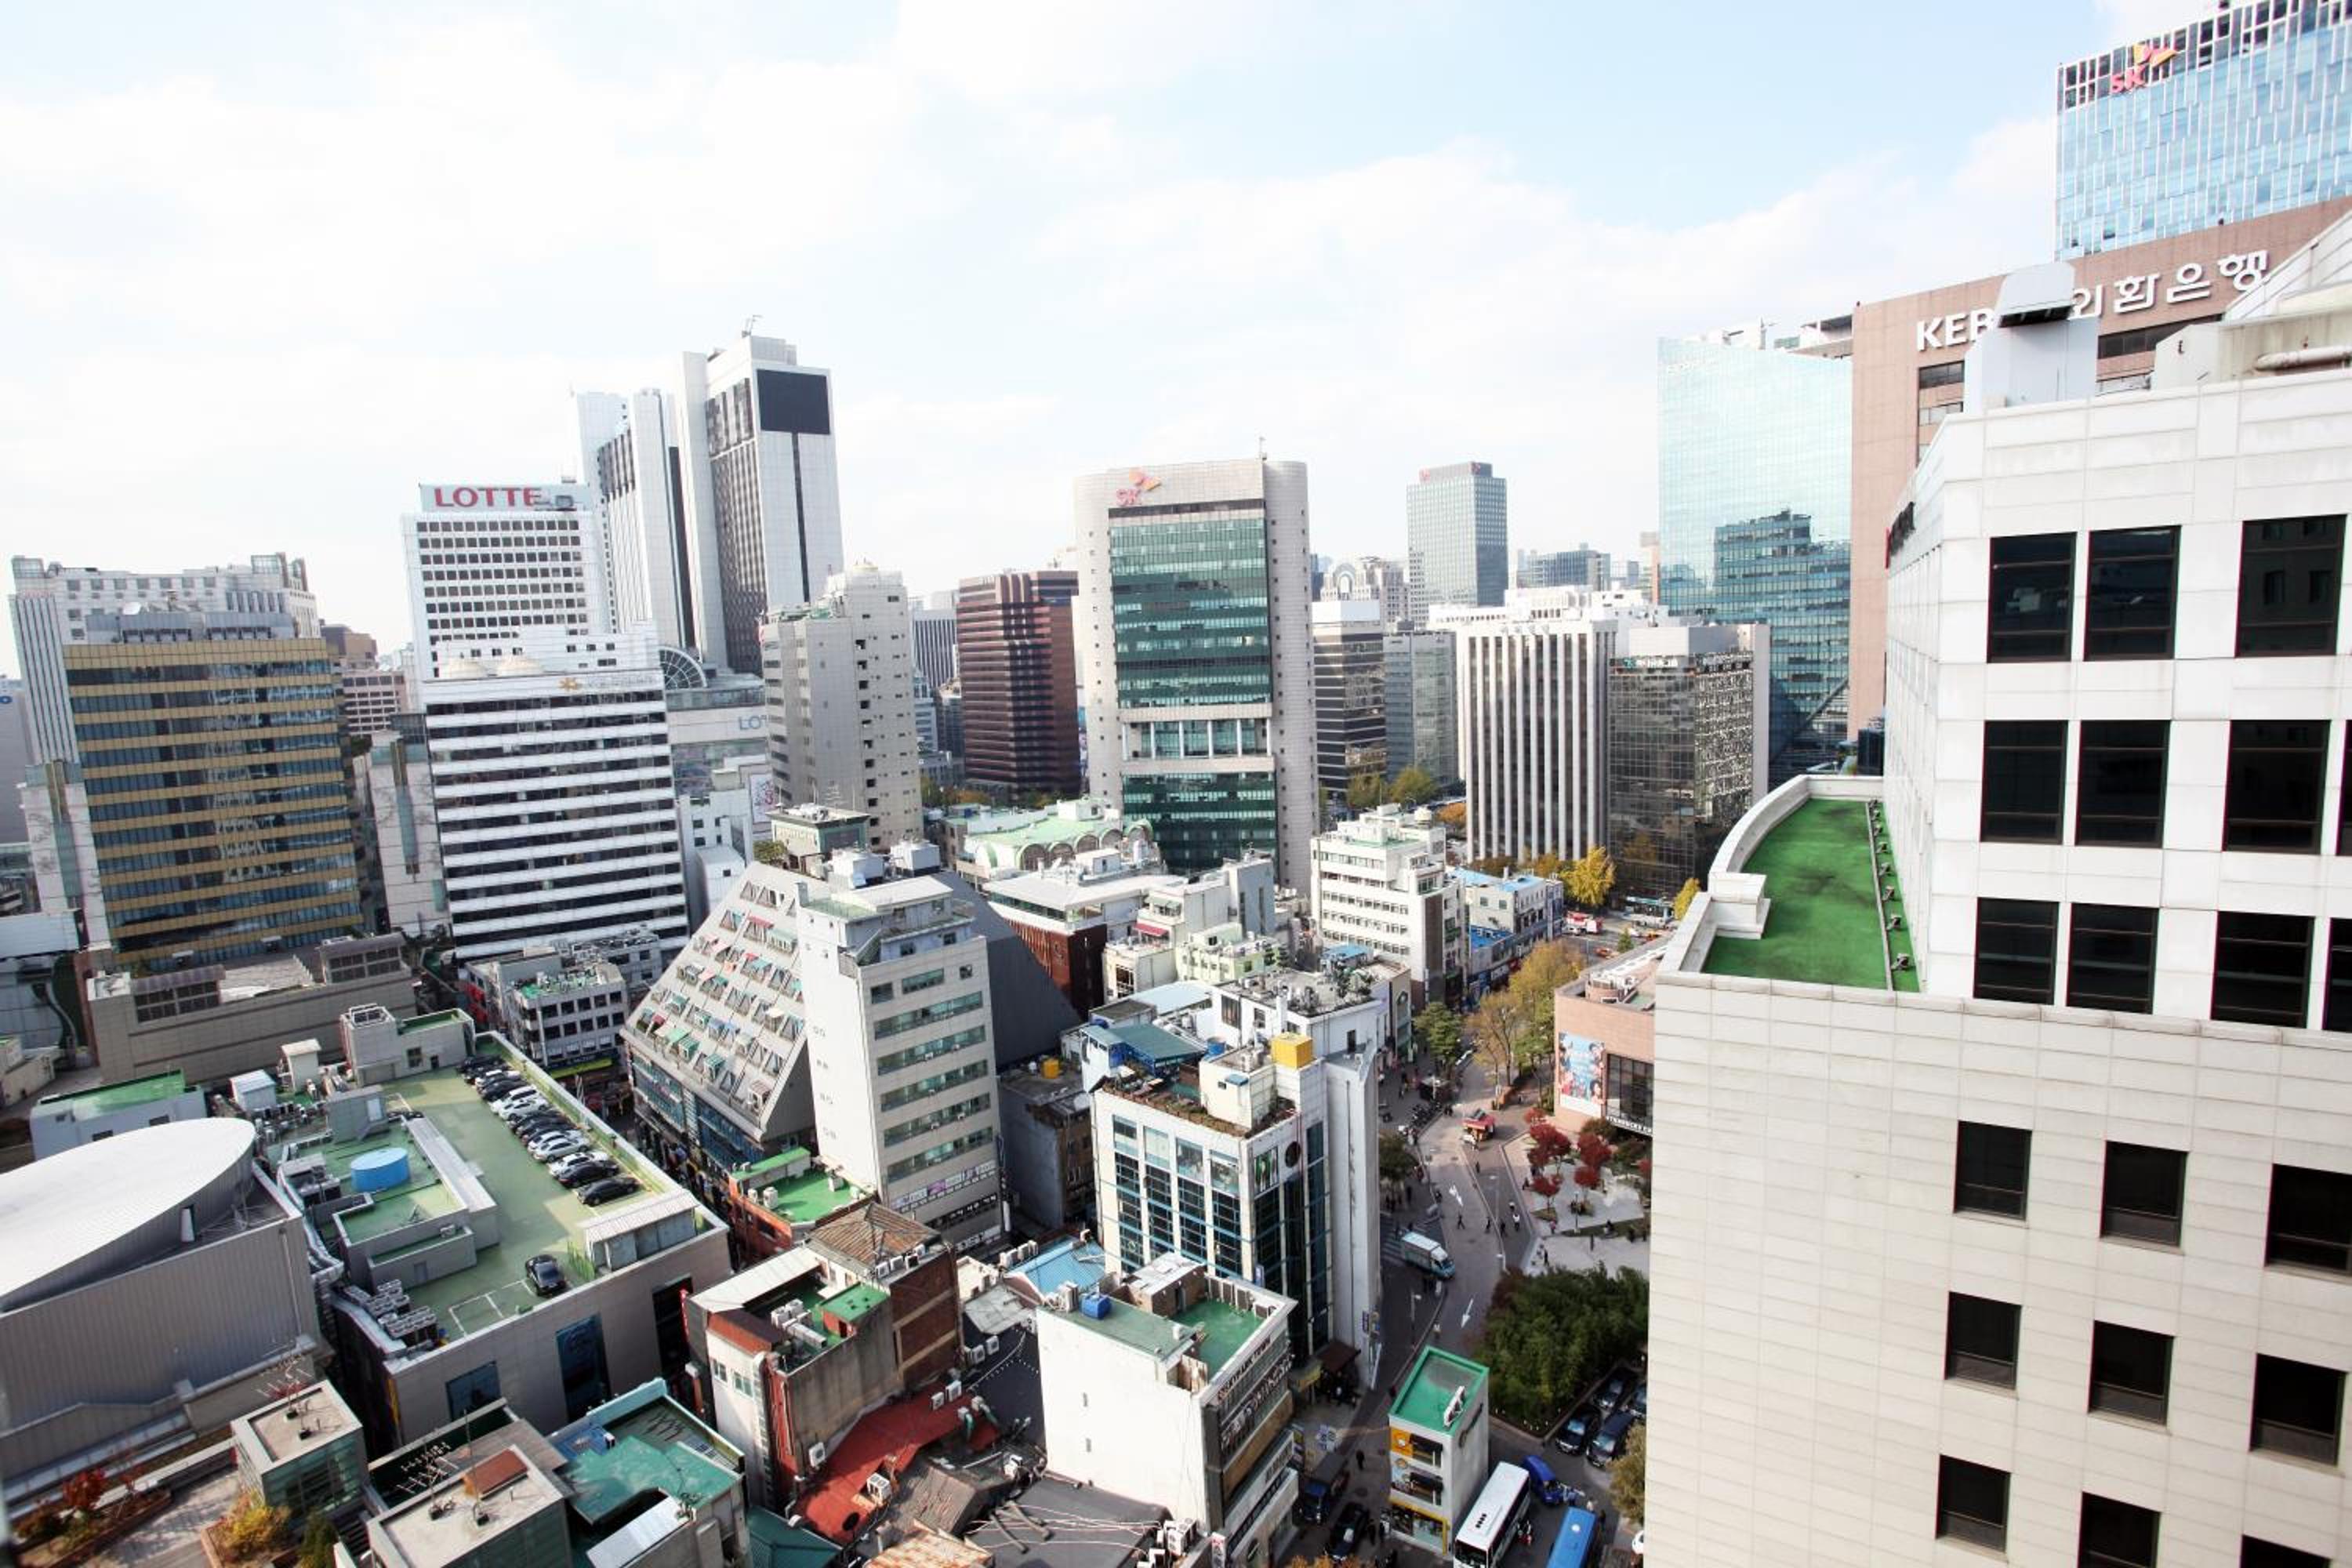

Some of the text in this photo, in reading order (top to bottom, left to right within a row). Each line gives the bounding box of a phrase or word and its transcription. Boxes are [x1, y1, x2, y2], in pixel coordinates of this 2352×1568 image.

[2111, 65, 2146, 94] SK
[2068, 249, 2270, 320] 외환은행
[434, 487, 542, 507] LOTTE
